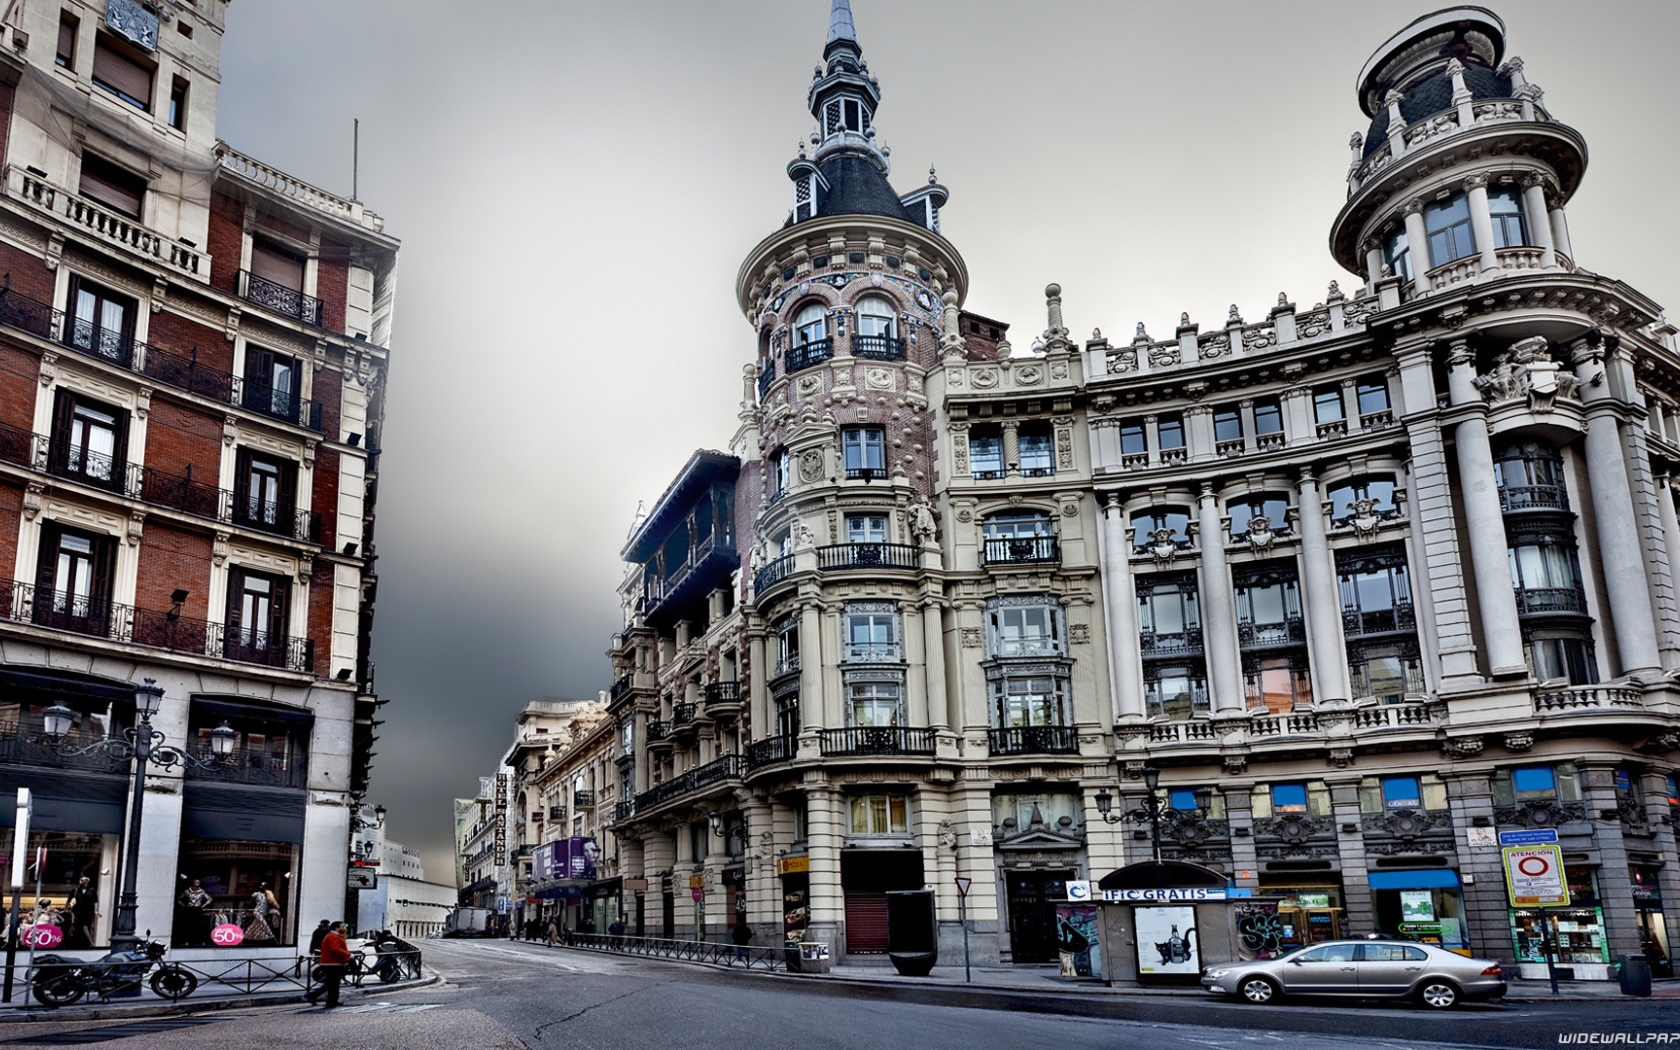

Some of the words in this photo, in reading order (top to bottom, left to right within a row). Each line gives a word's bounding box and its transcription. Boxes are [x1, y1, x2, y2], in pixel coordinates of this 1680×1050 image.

[497, 774, 506, 806] HOTEL
[496, 808, 506, 865] SANTANDER
[1143, 888, 1206, 899] GRATIS
[735, 899, 746, 912] 49
[25, 931, 62, 945] 50%
[213, 930, 244, 943] 50%
